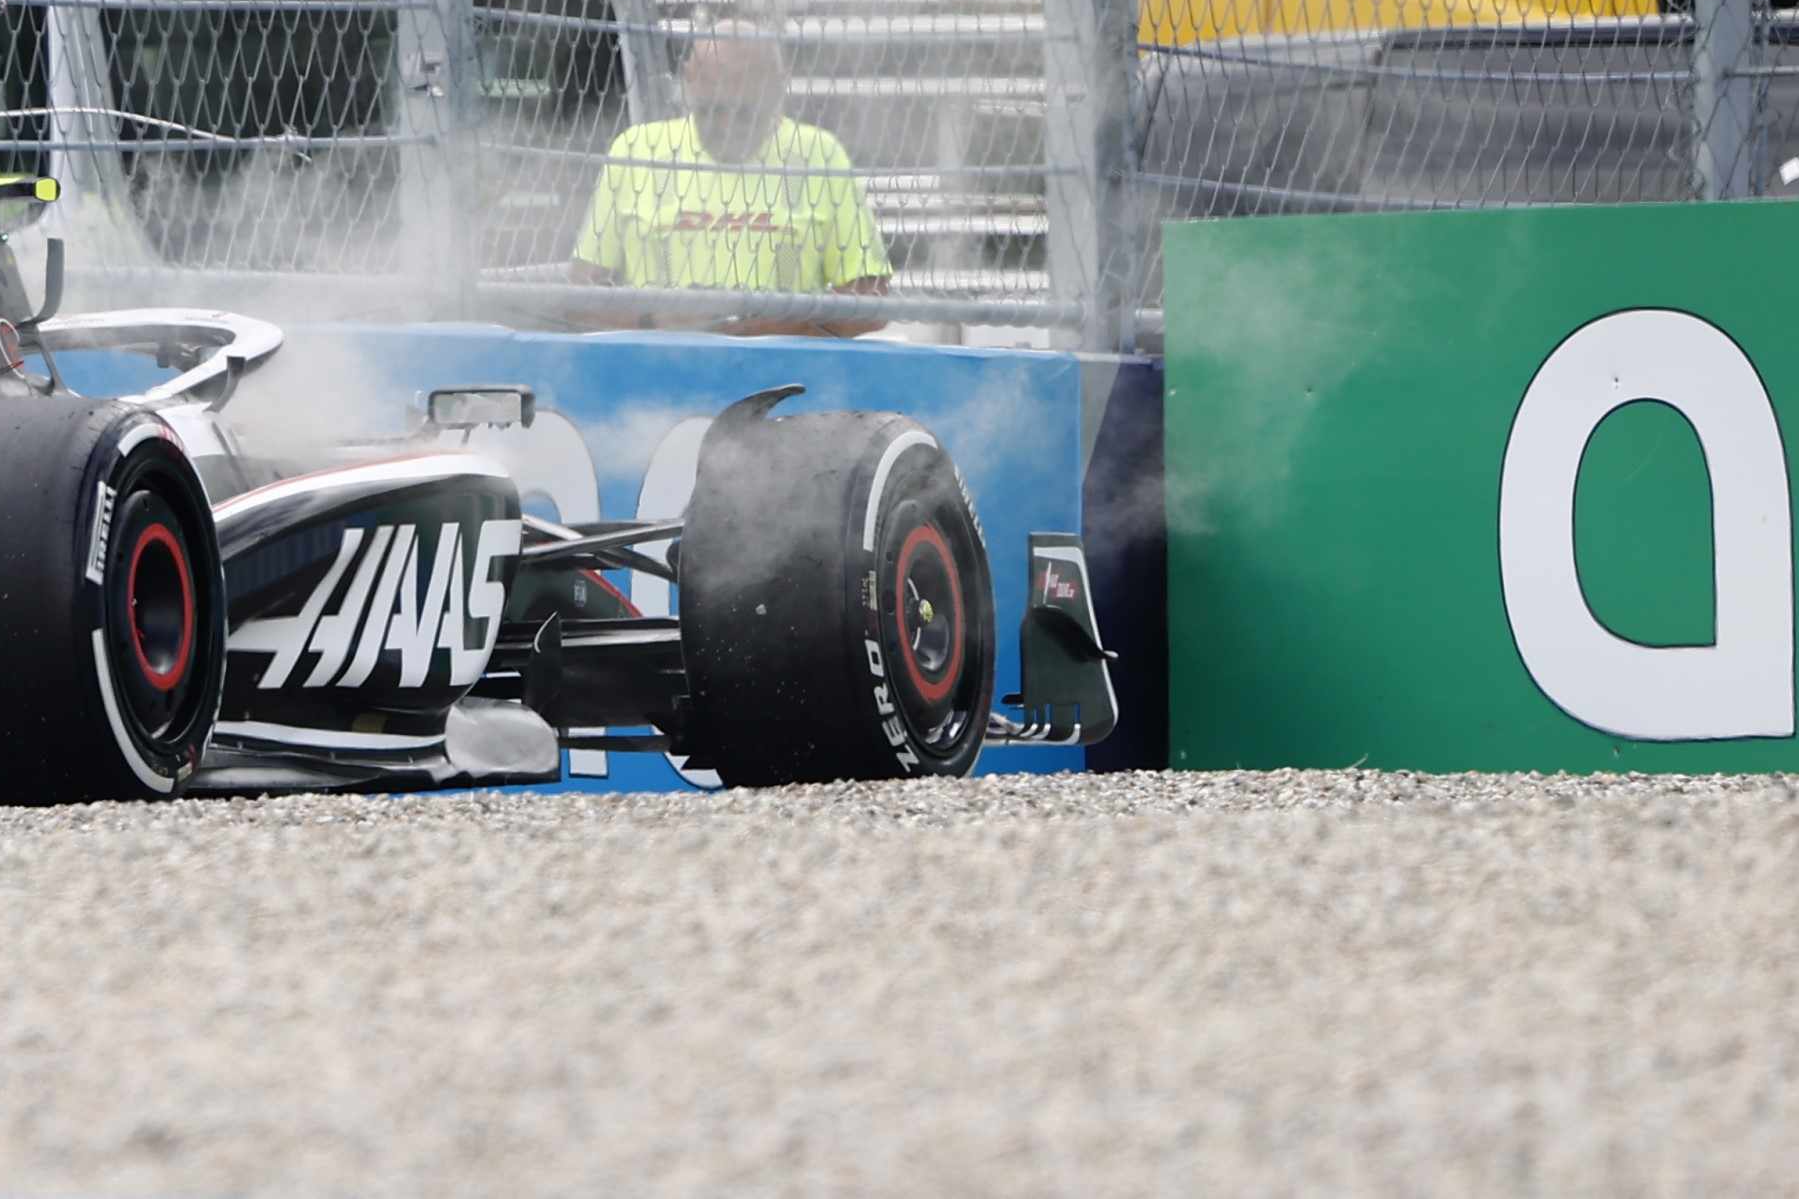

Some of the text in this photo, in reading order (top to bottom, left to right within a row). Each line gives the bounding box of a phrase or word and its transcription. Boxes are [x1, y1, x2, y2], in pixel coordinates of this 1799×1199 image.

[674, 211, 780, 232] DHL
[226, 519, 523, 690] HAAS
[864, 638, 921, 773] ZERO
